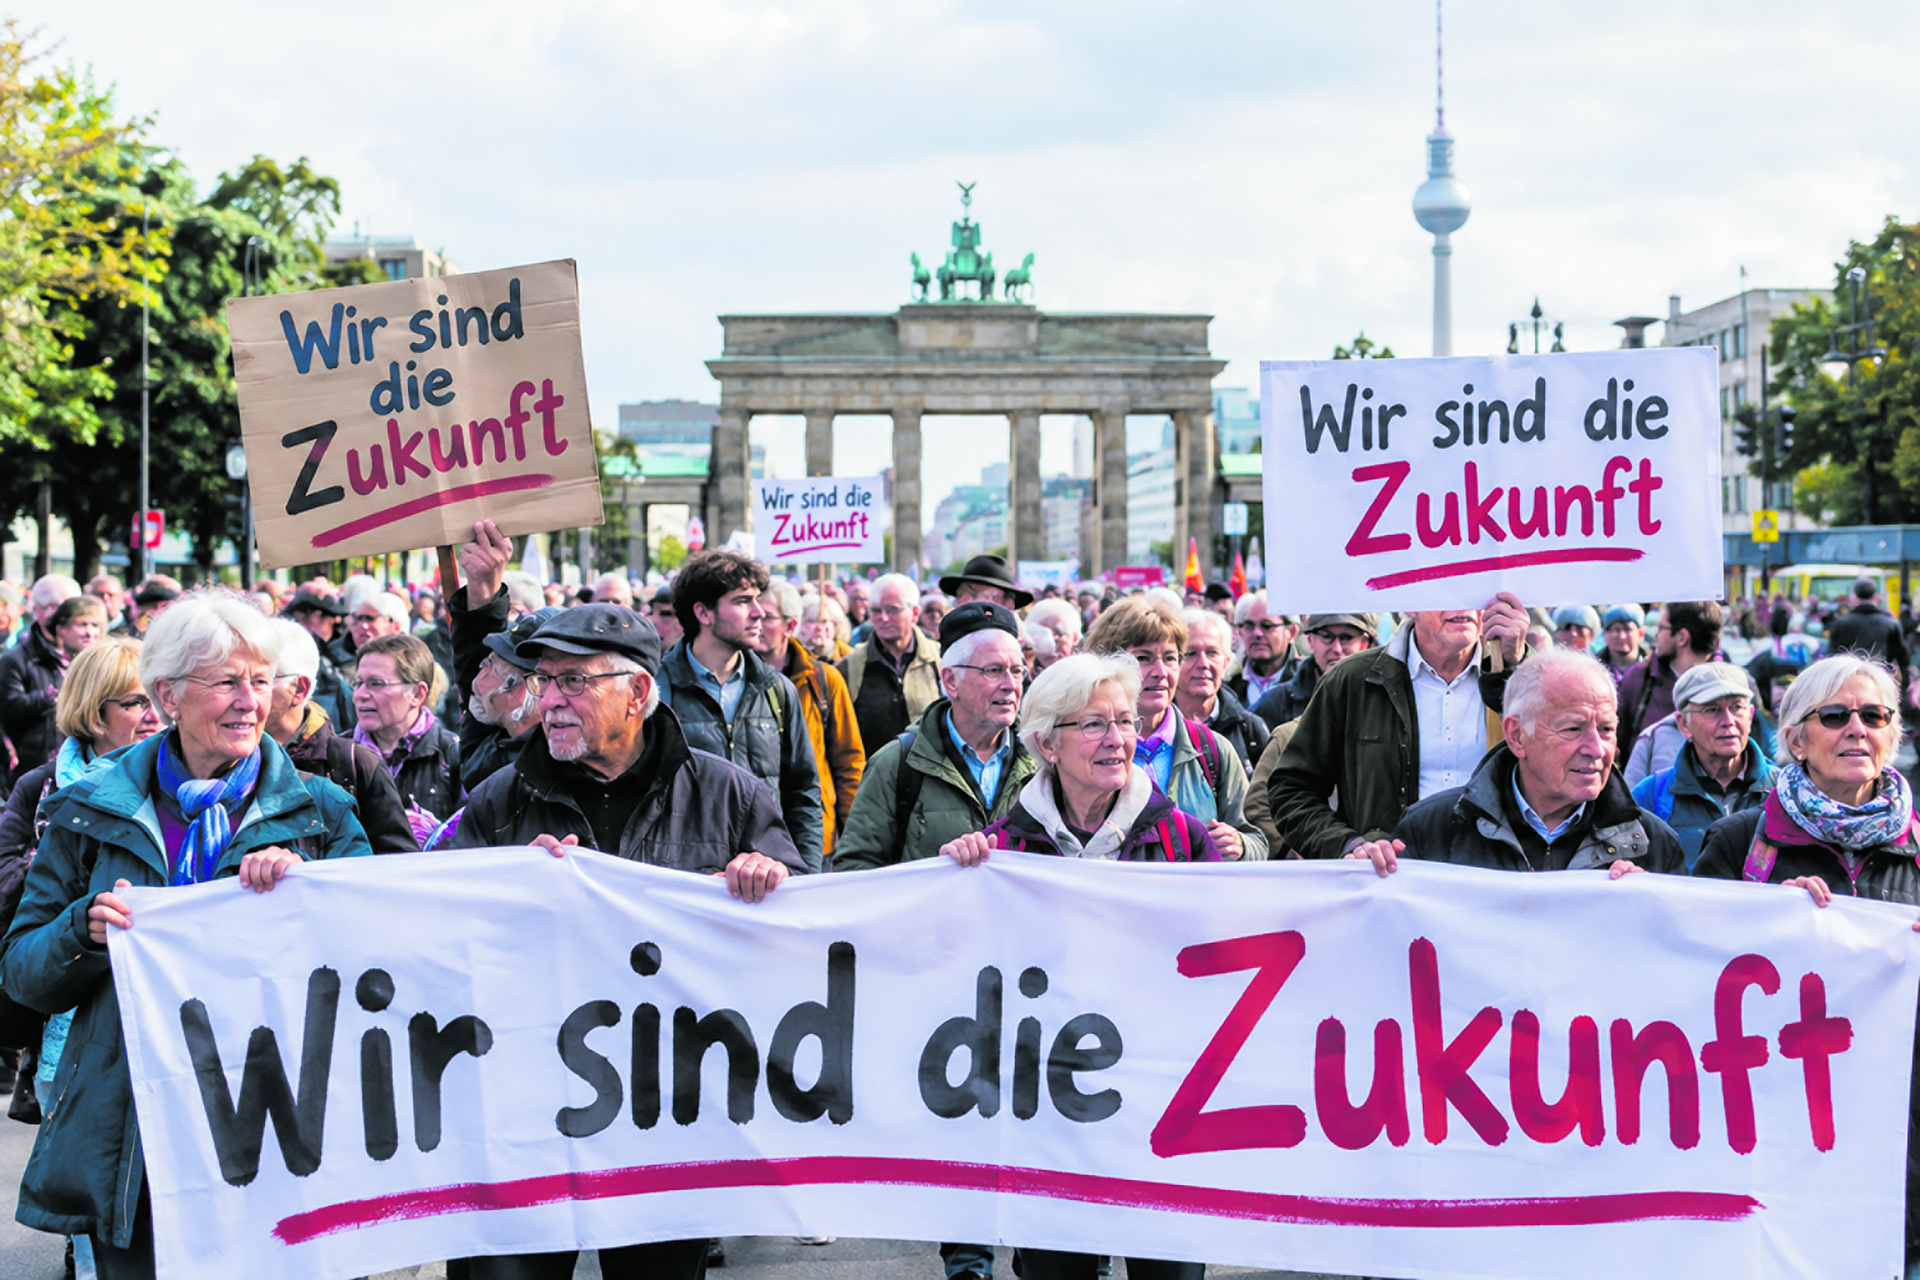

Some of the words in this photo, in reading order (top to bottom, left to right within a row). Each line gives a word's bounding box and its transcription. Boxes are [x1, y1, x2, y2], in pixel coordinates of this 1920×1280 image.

[279, 302, 388, 375] Wir
[409, 277, 525, 354] sind
[369, 361, 455, 415] die
[1299, 383, 1407, 454] Wir
[1432, 376, 1547, 449] sind
[1583, 377, 1669, 441] die
[281, 378, 568, 515] Zukunft
[761, 486, 794, 510] Wir
[800, 485, 837, 509] sind
[845, 484, 872, 507] die
[771, 511, 868, 545] Zukunft
[1345, 455, 1663, 557] Zukunft
[180, 965, 493, 1186] Wir
[555, 941, 856, 1139] sind
[918, 965, 1123, 1123] die
[1150, 930, 1854, 1158] Zukunft
